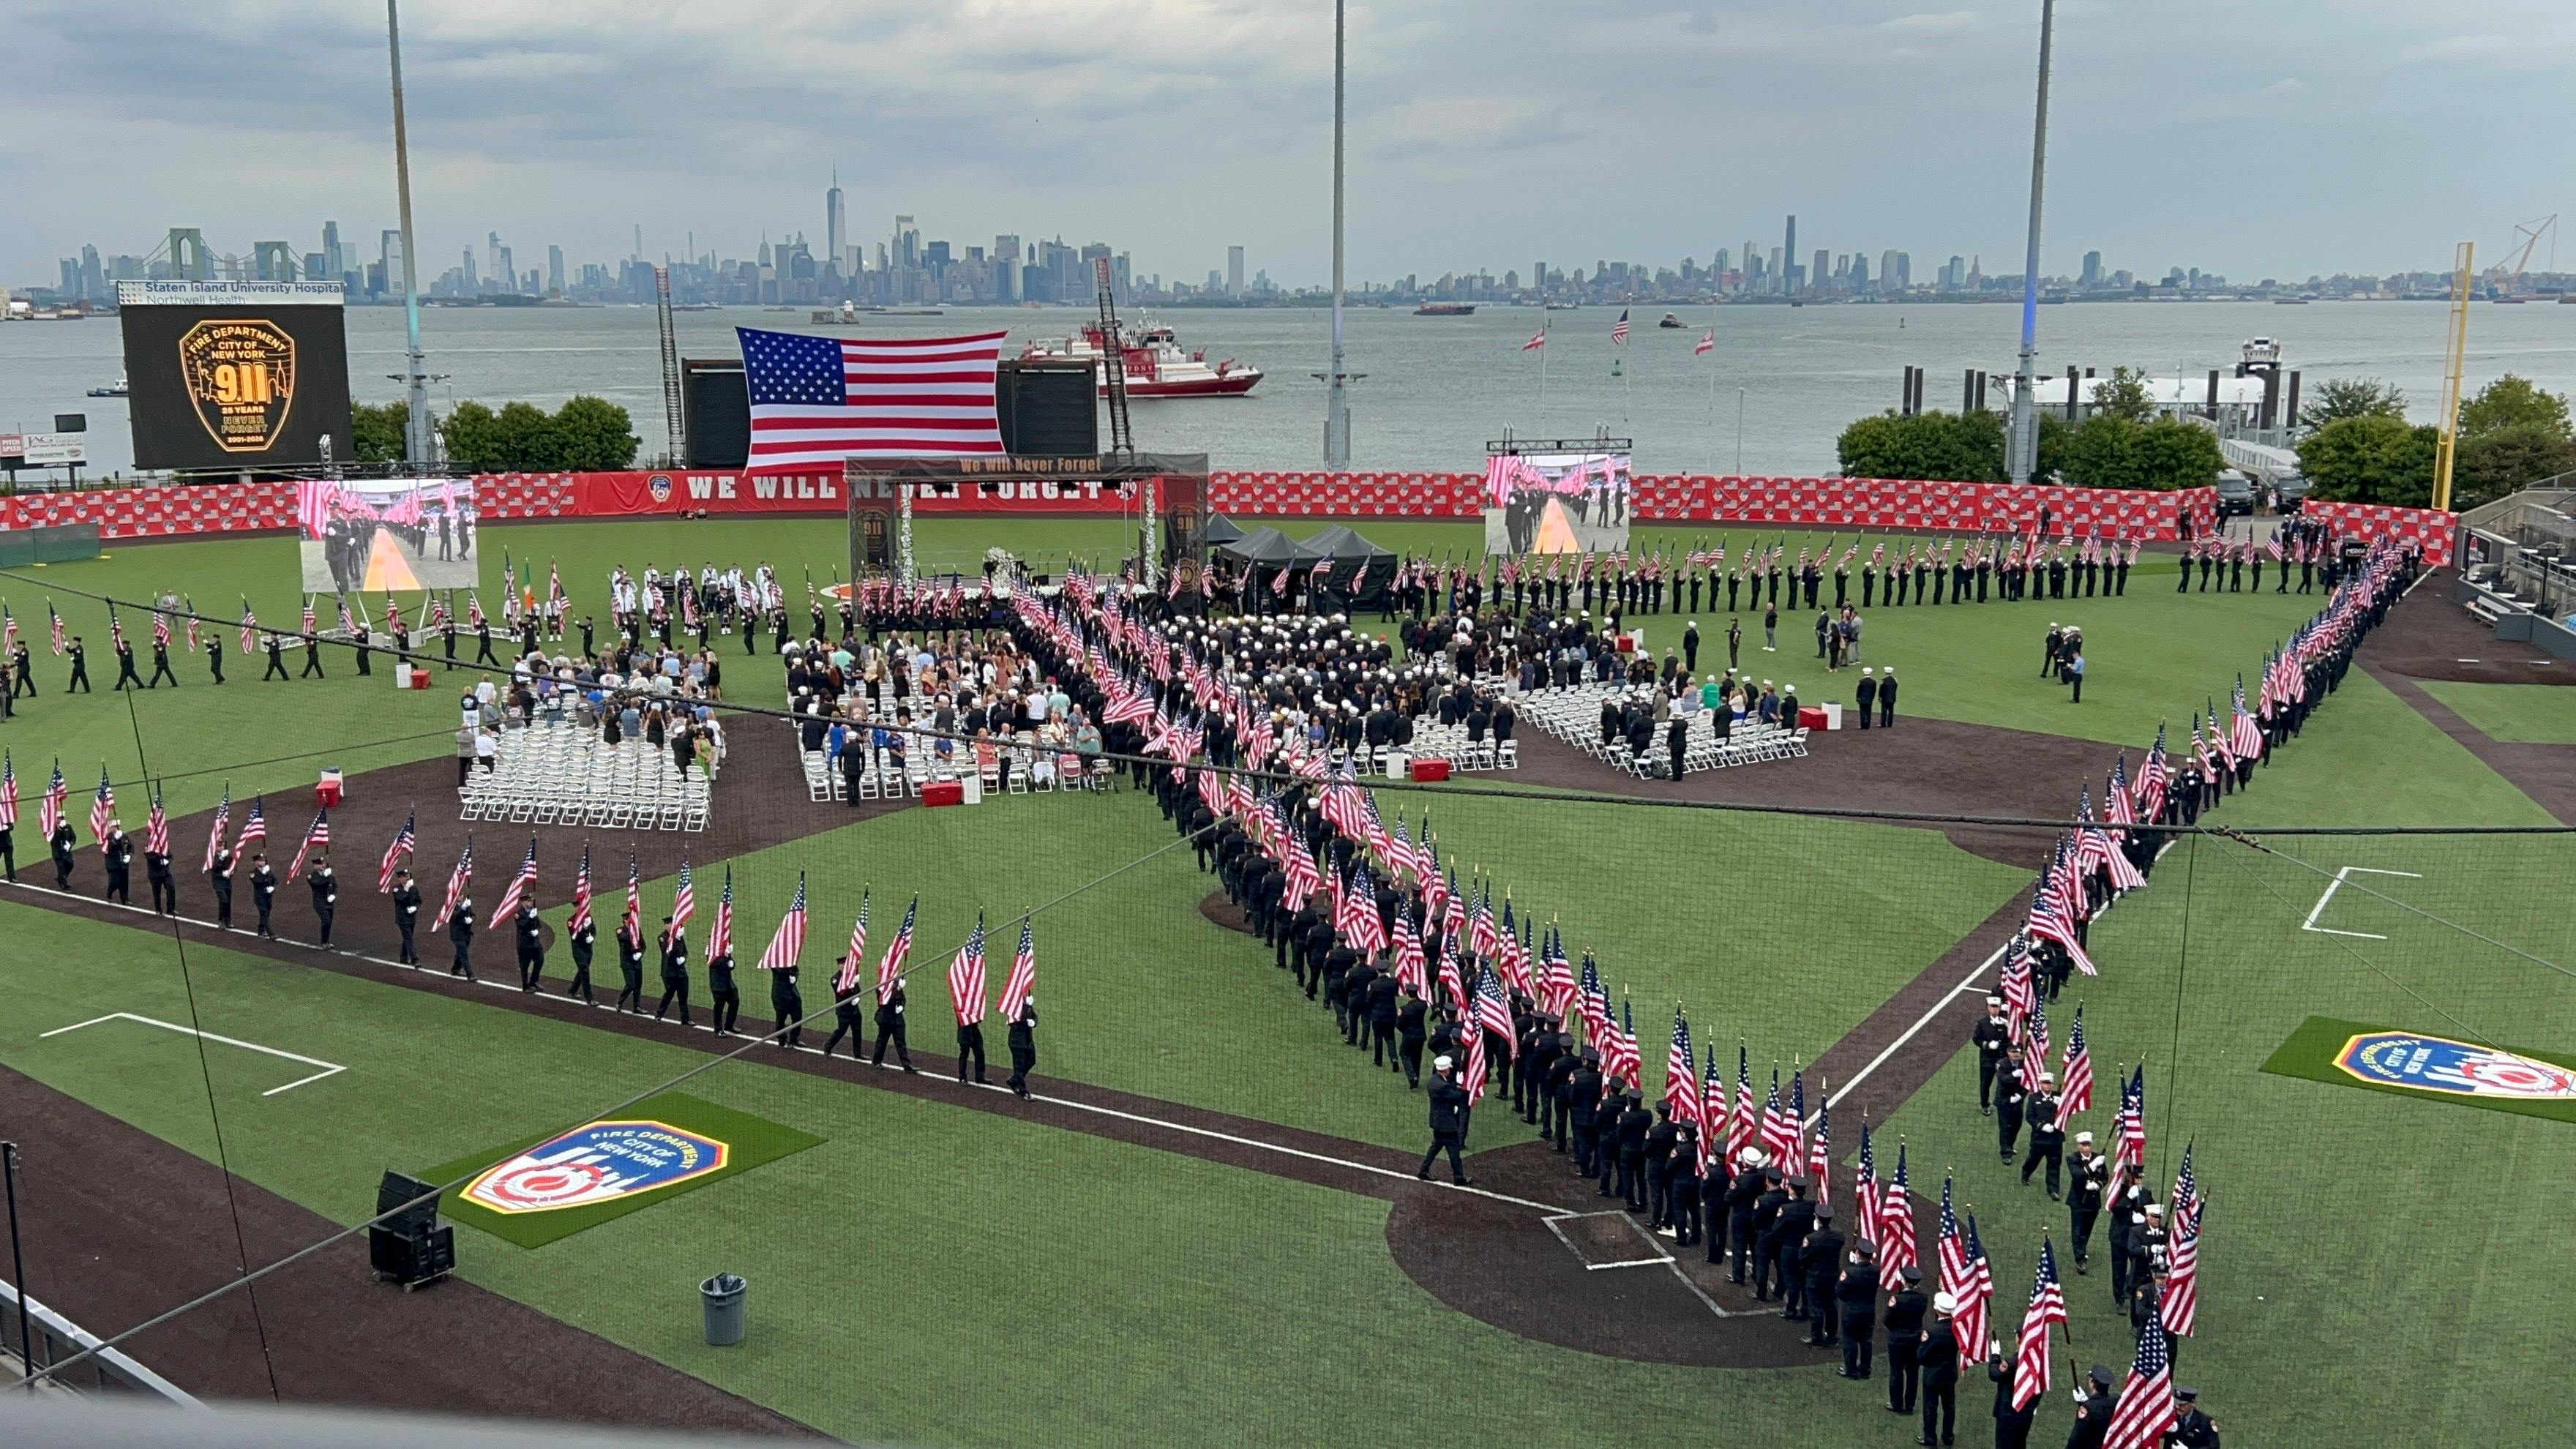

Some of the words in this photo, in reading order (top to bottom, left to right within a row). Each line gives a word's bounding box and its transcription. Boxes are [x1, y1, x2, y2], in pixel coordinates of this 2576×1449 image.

[146, 282, 187, 293] Staten
[191, 282, 226, 293] Island
[231, 282, 291, 294] University
[295, 282, 344, 294] Hospital
[147, 295, 206, 305] Northwell
[209, 295, 246, 305] Health
[189, 334, 212, 354] FIRE
[212, 326, 287, 352] DEPARTMENT
[218, 341, 242, 350] CITY
[244, 341, 258, 350] OF
[211, 351, 235, 359] NEW
[237, 350, 266, 359] YORK
[222, 406, 233, 414] 25
[234, 405, 265, 413] YEARS
[222, 416, 266, 424] NEVER
[221, 424, 269, 434] FORGET
[960, 458, 981, 473] We
[985, 457, 1011, 472] Will
[1015, 457, 1053, 472] Never
[1057, 457, 1101, 473] Forget
[687, 476, 735, 499] WE
[752, 476, 836, 499] WILL
[590, 1130, 635, 1139] FIRE
[637, 1131, 699, 1169] DEPARTMENT
[622, 1138, 658, 1152] CITY
[652, 1148, 677, 1157] OF
[594, 1142, 632, 1156] NEW
[626, 1151, 667, 1169] YORK
